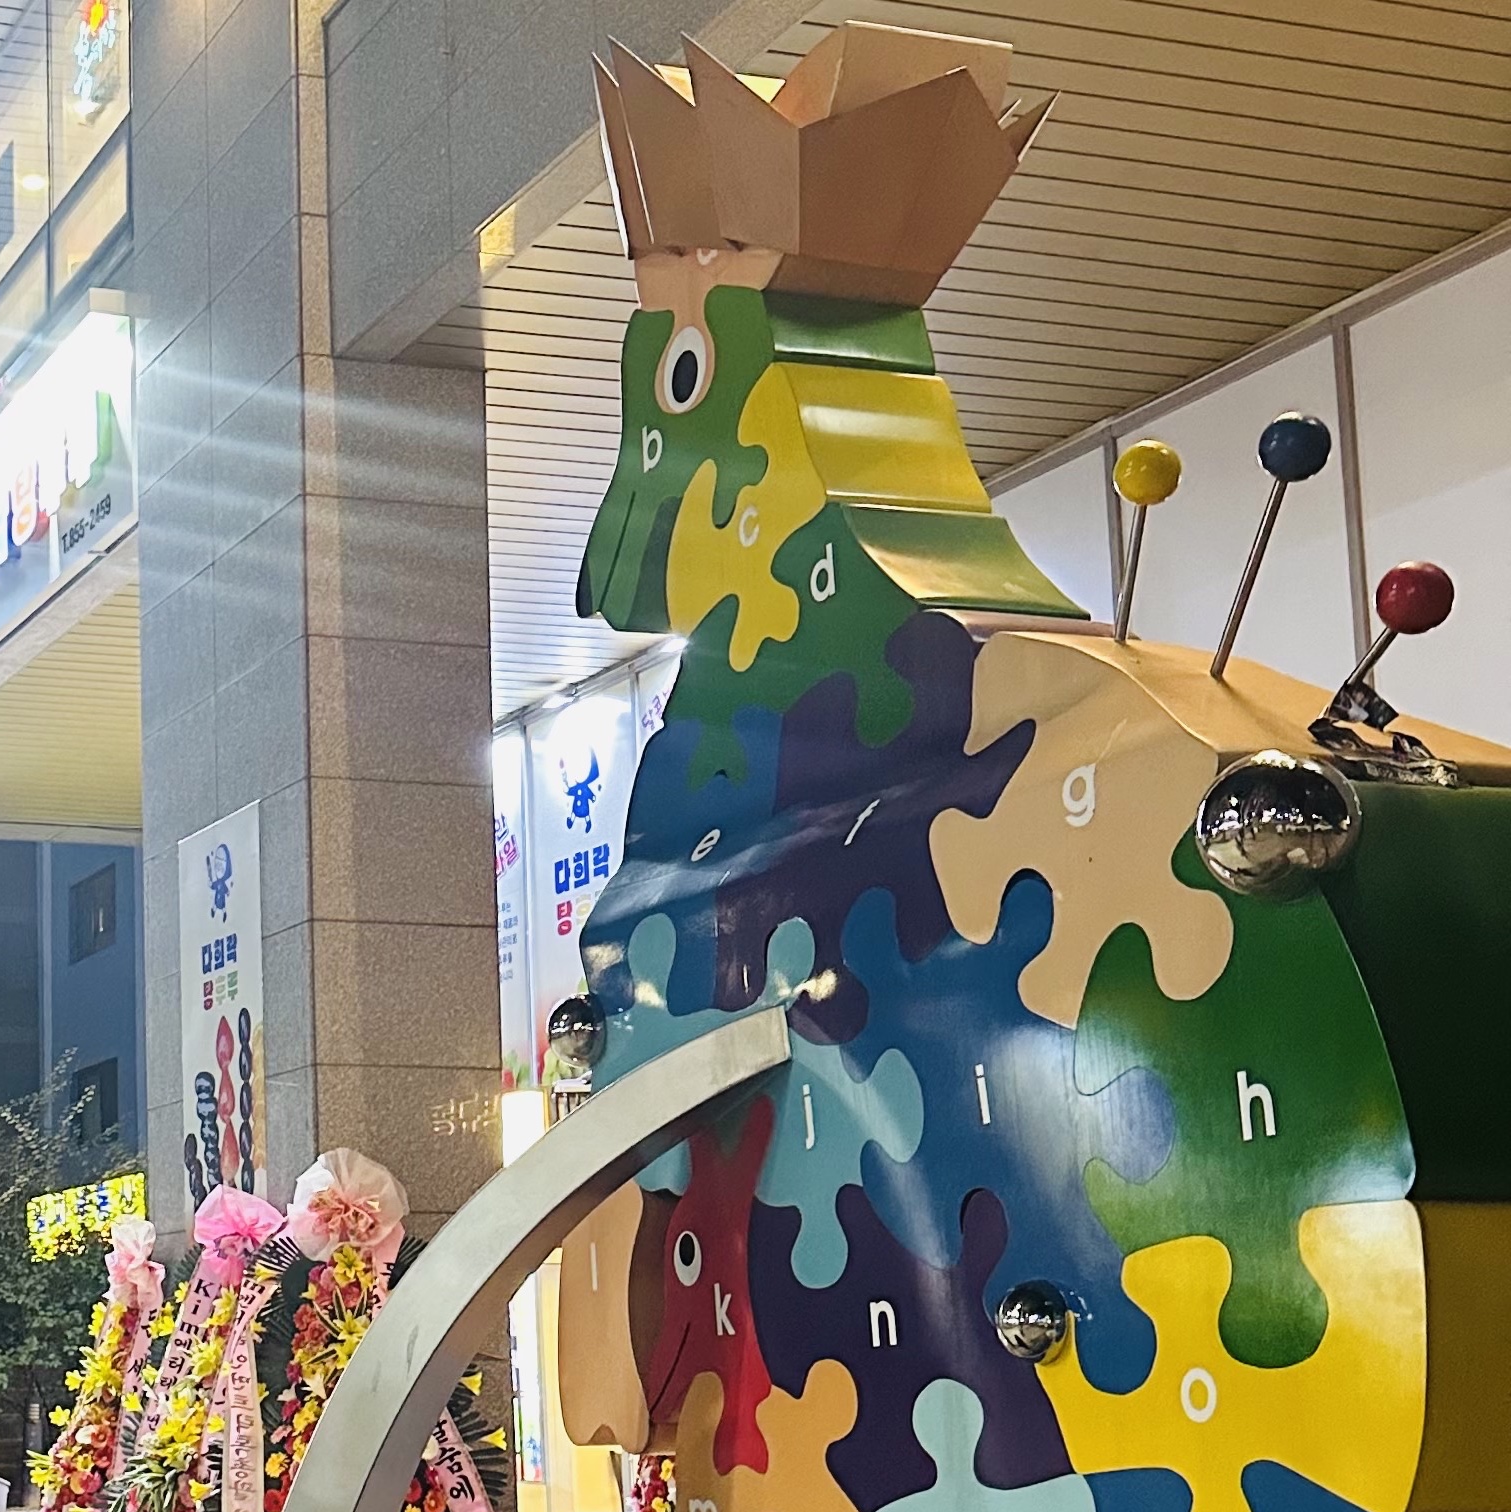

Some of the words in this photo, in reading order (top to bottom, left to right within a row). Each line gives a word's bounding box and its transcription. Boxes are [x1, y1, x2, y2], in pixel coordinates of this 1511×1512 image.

[641, 425, 663, 473] b
[61, 493, 112, 555] T.855-2459
[738, 506, 760, 548] c
[810, 542, 837, 602] d
[1062, 762, 1096, 827] g
[690, 828, 721, 862] e
[844, 798, 880, 846] f
[554, 842, 610, 895] 다희락
[202, 933, 237, 974] 다희락
[802, 1084, 815, 1150] j
[975, 1063, 991, 1125] i
[1236, 1070, 1276, 1142] h
[713, 1282, 736, 1336] k
[868, 1298, 898, 1348] n
[1180, 1367, 1217, 1423] o
